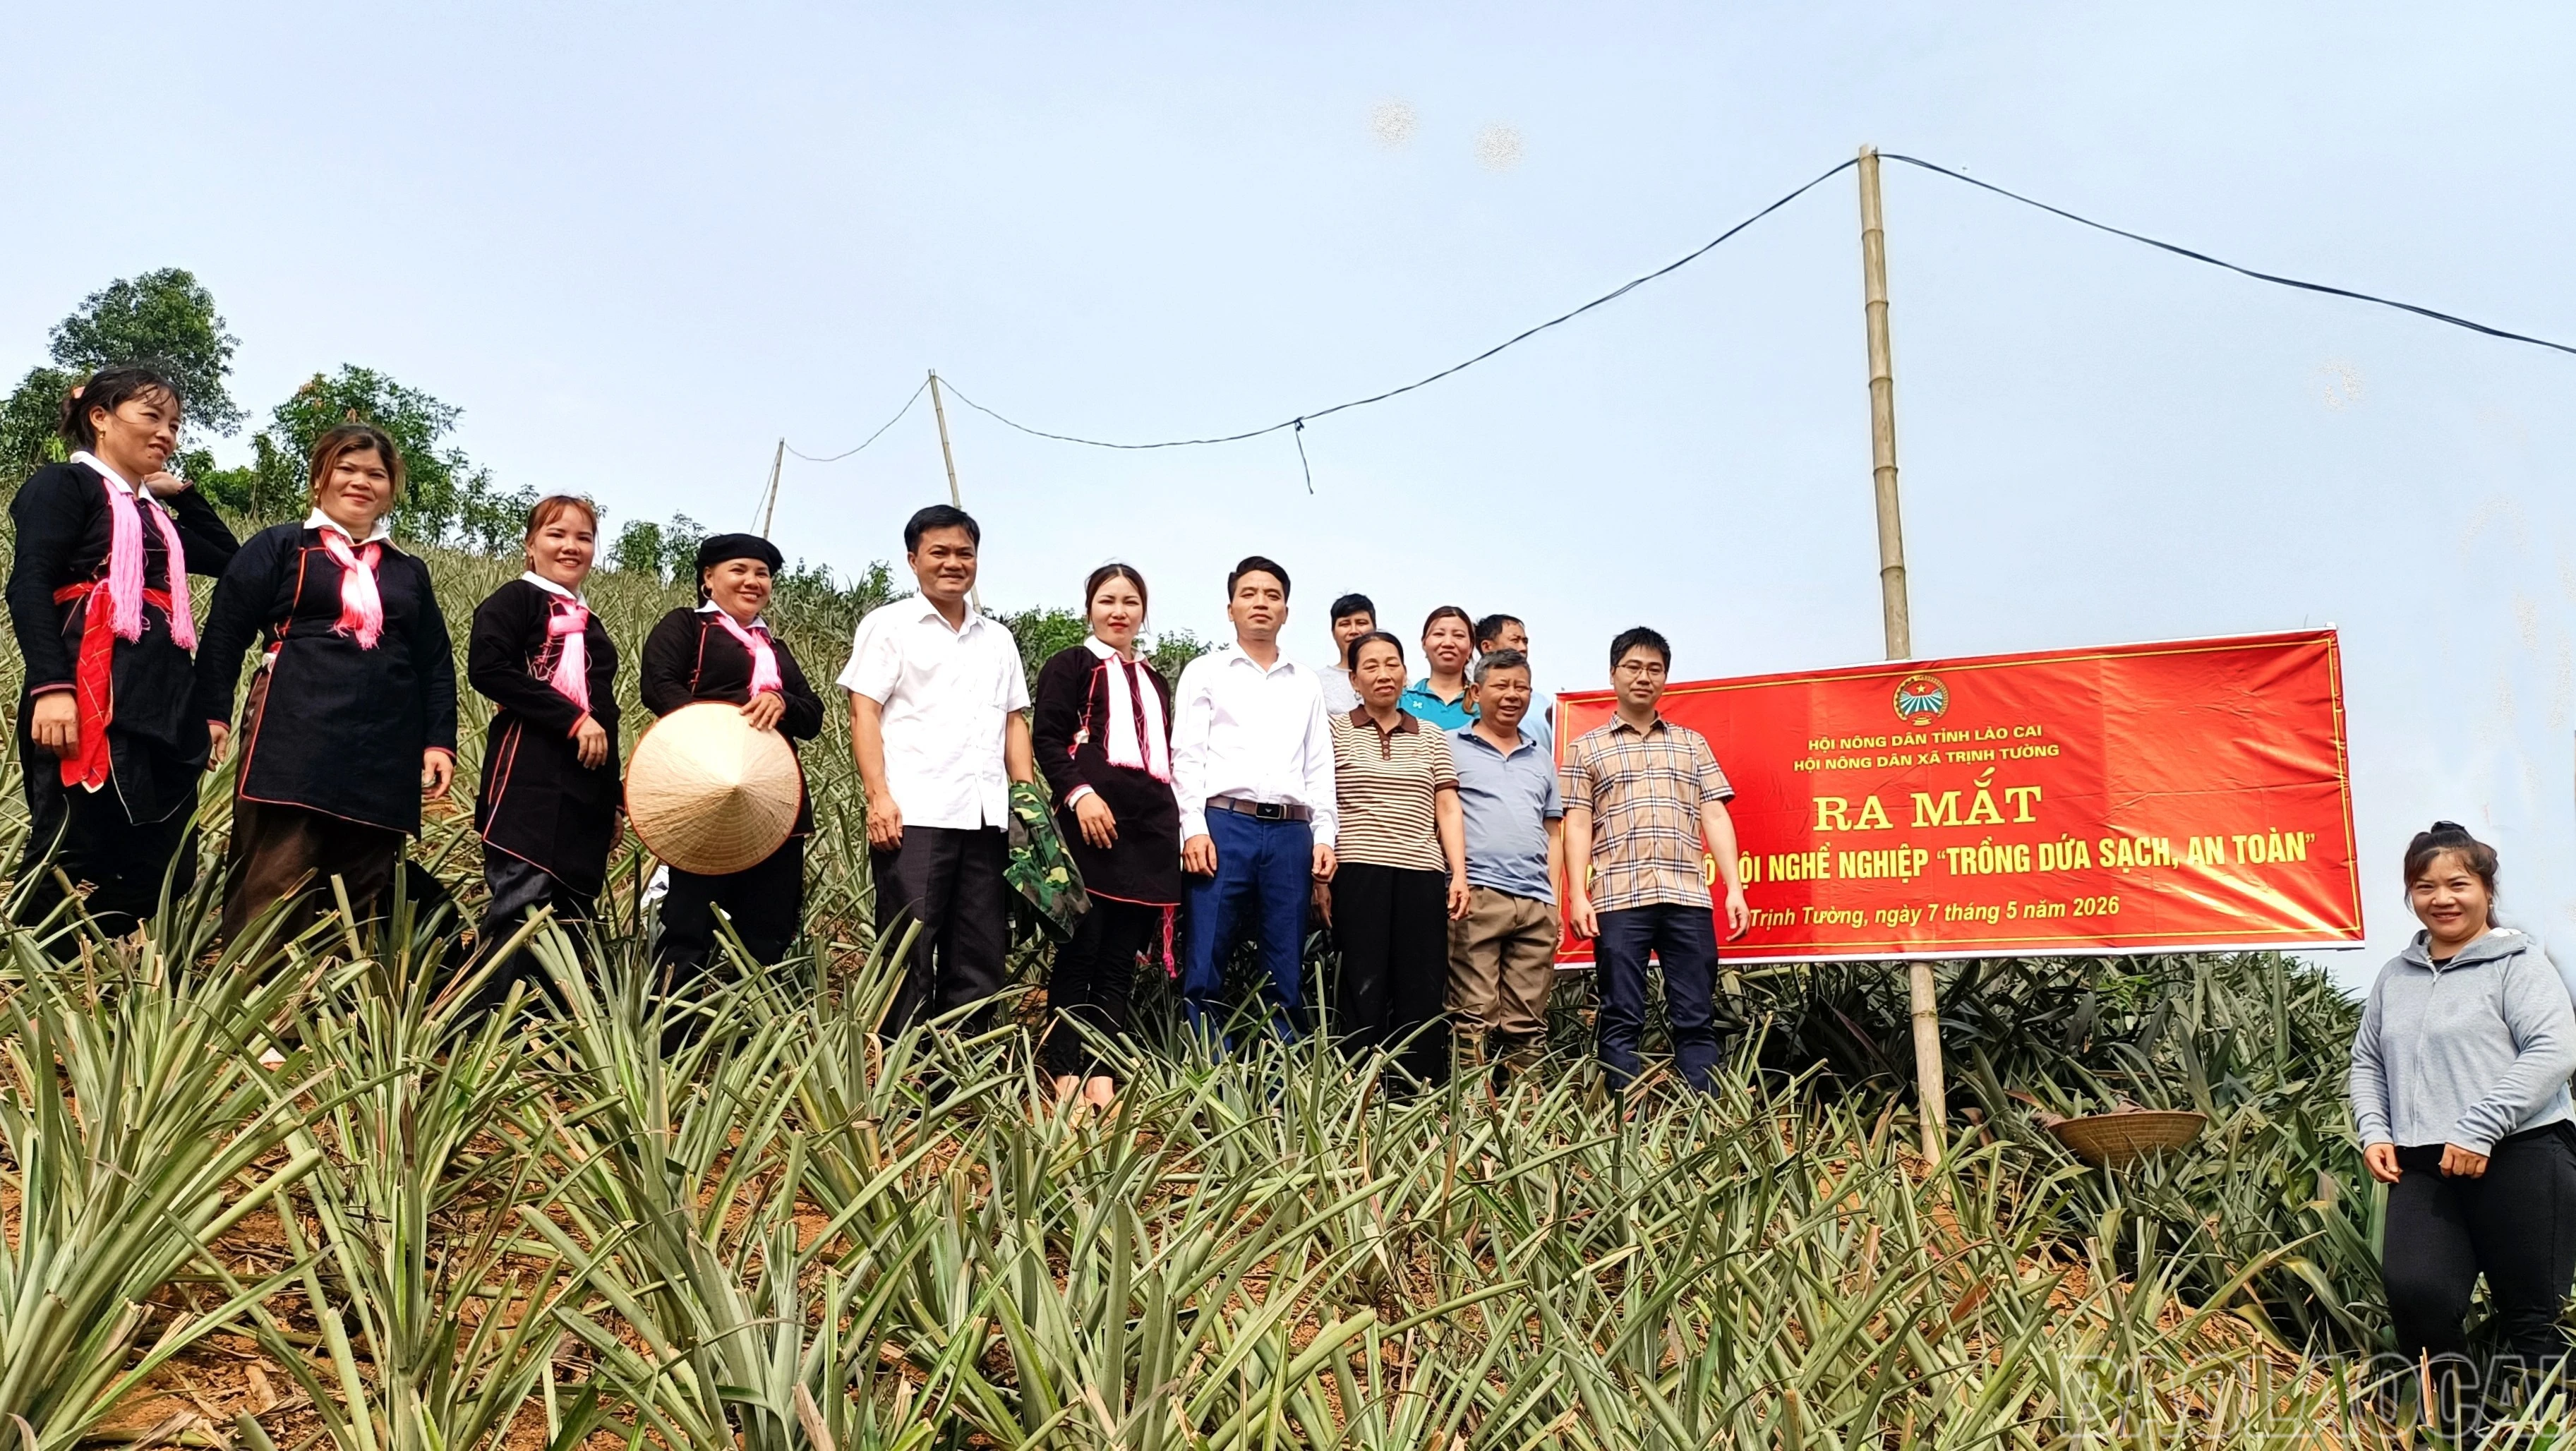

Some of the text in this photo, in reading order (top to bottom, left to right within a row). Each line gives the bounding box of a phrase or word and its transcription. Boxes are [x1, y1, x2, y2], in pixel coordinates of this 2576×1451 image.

[1808, 725, 2042, 753] HỘI NÔNG DÂN TỈNH LÀO CAI
[1793, 743, 2060, 774] HỘI NÔNG DÂN XÃ TRỊNH TƯỜNG
[1812, 766, 2042, 831] RA MẮT
[1738, 850, 1761, 890] ỘI
[1768, 842, 1831, 882] NGHỀ
[1838, 843, 1929, 884] NGHIỆP
[1937, 836, 2031, 876] “TRỒNG
[2038, 833, 2093, 872] DỨA
[2098, 836, 2179, 874] SẠCH,
[2186, 836, 2226, 865] AN
[2232, 827, 2316, 865] TOÀN”
[1750, 896, 2121, 931] Trịnh Tường, ngày 7 tháng 5 năm 2026
